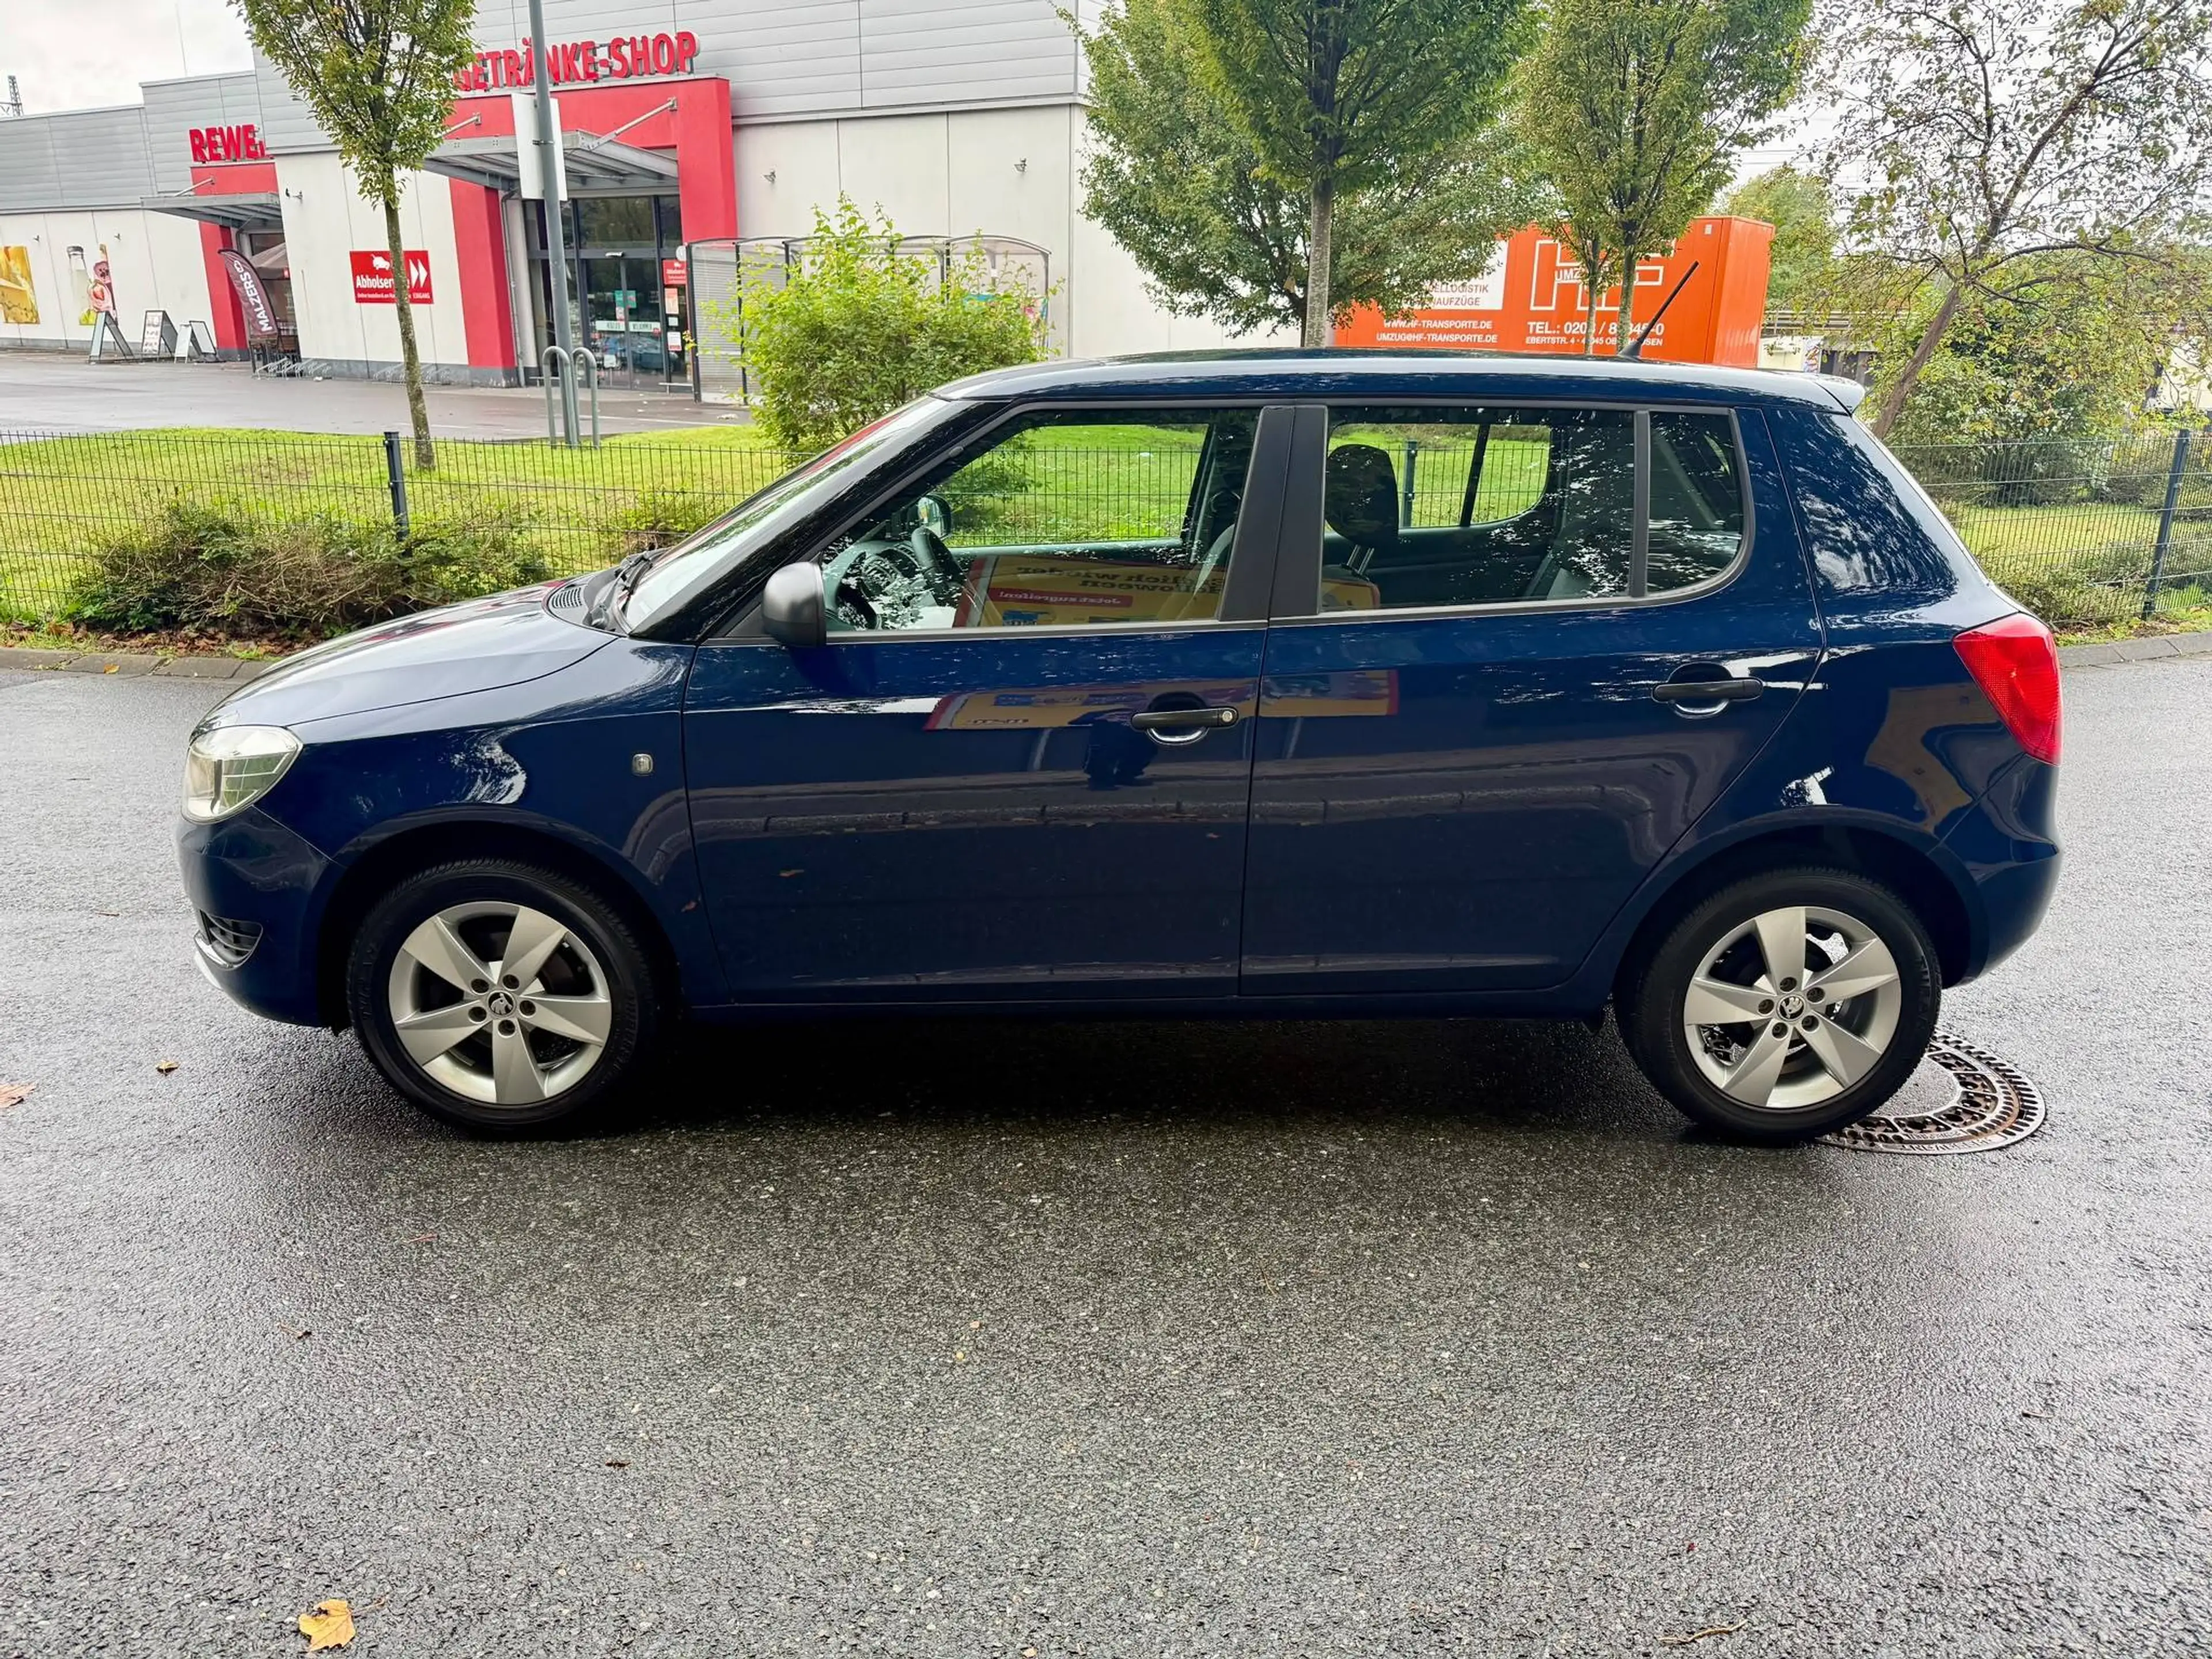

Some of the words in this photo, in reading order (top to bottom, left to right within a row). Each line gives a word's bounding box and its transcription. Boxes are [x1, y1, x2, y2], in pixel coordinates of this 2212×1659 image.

[189, 123, 259, 162] REWE
[239, 271, 273, 332] MALZERS
[1527, 321, 1560, 334] TEL.:
